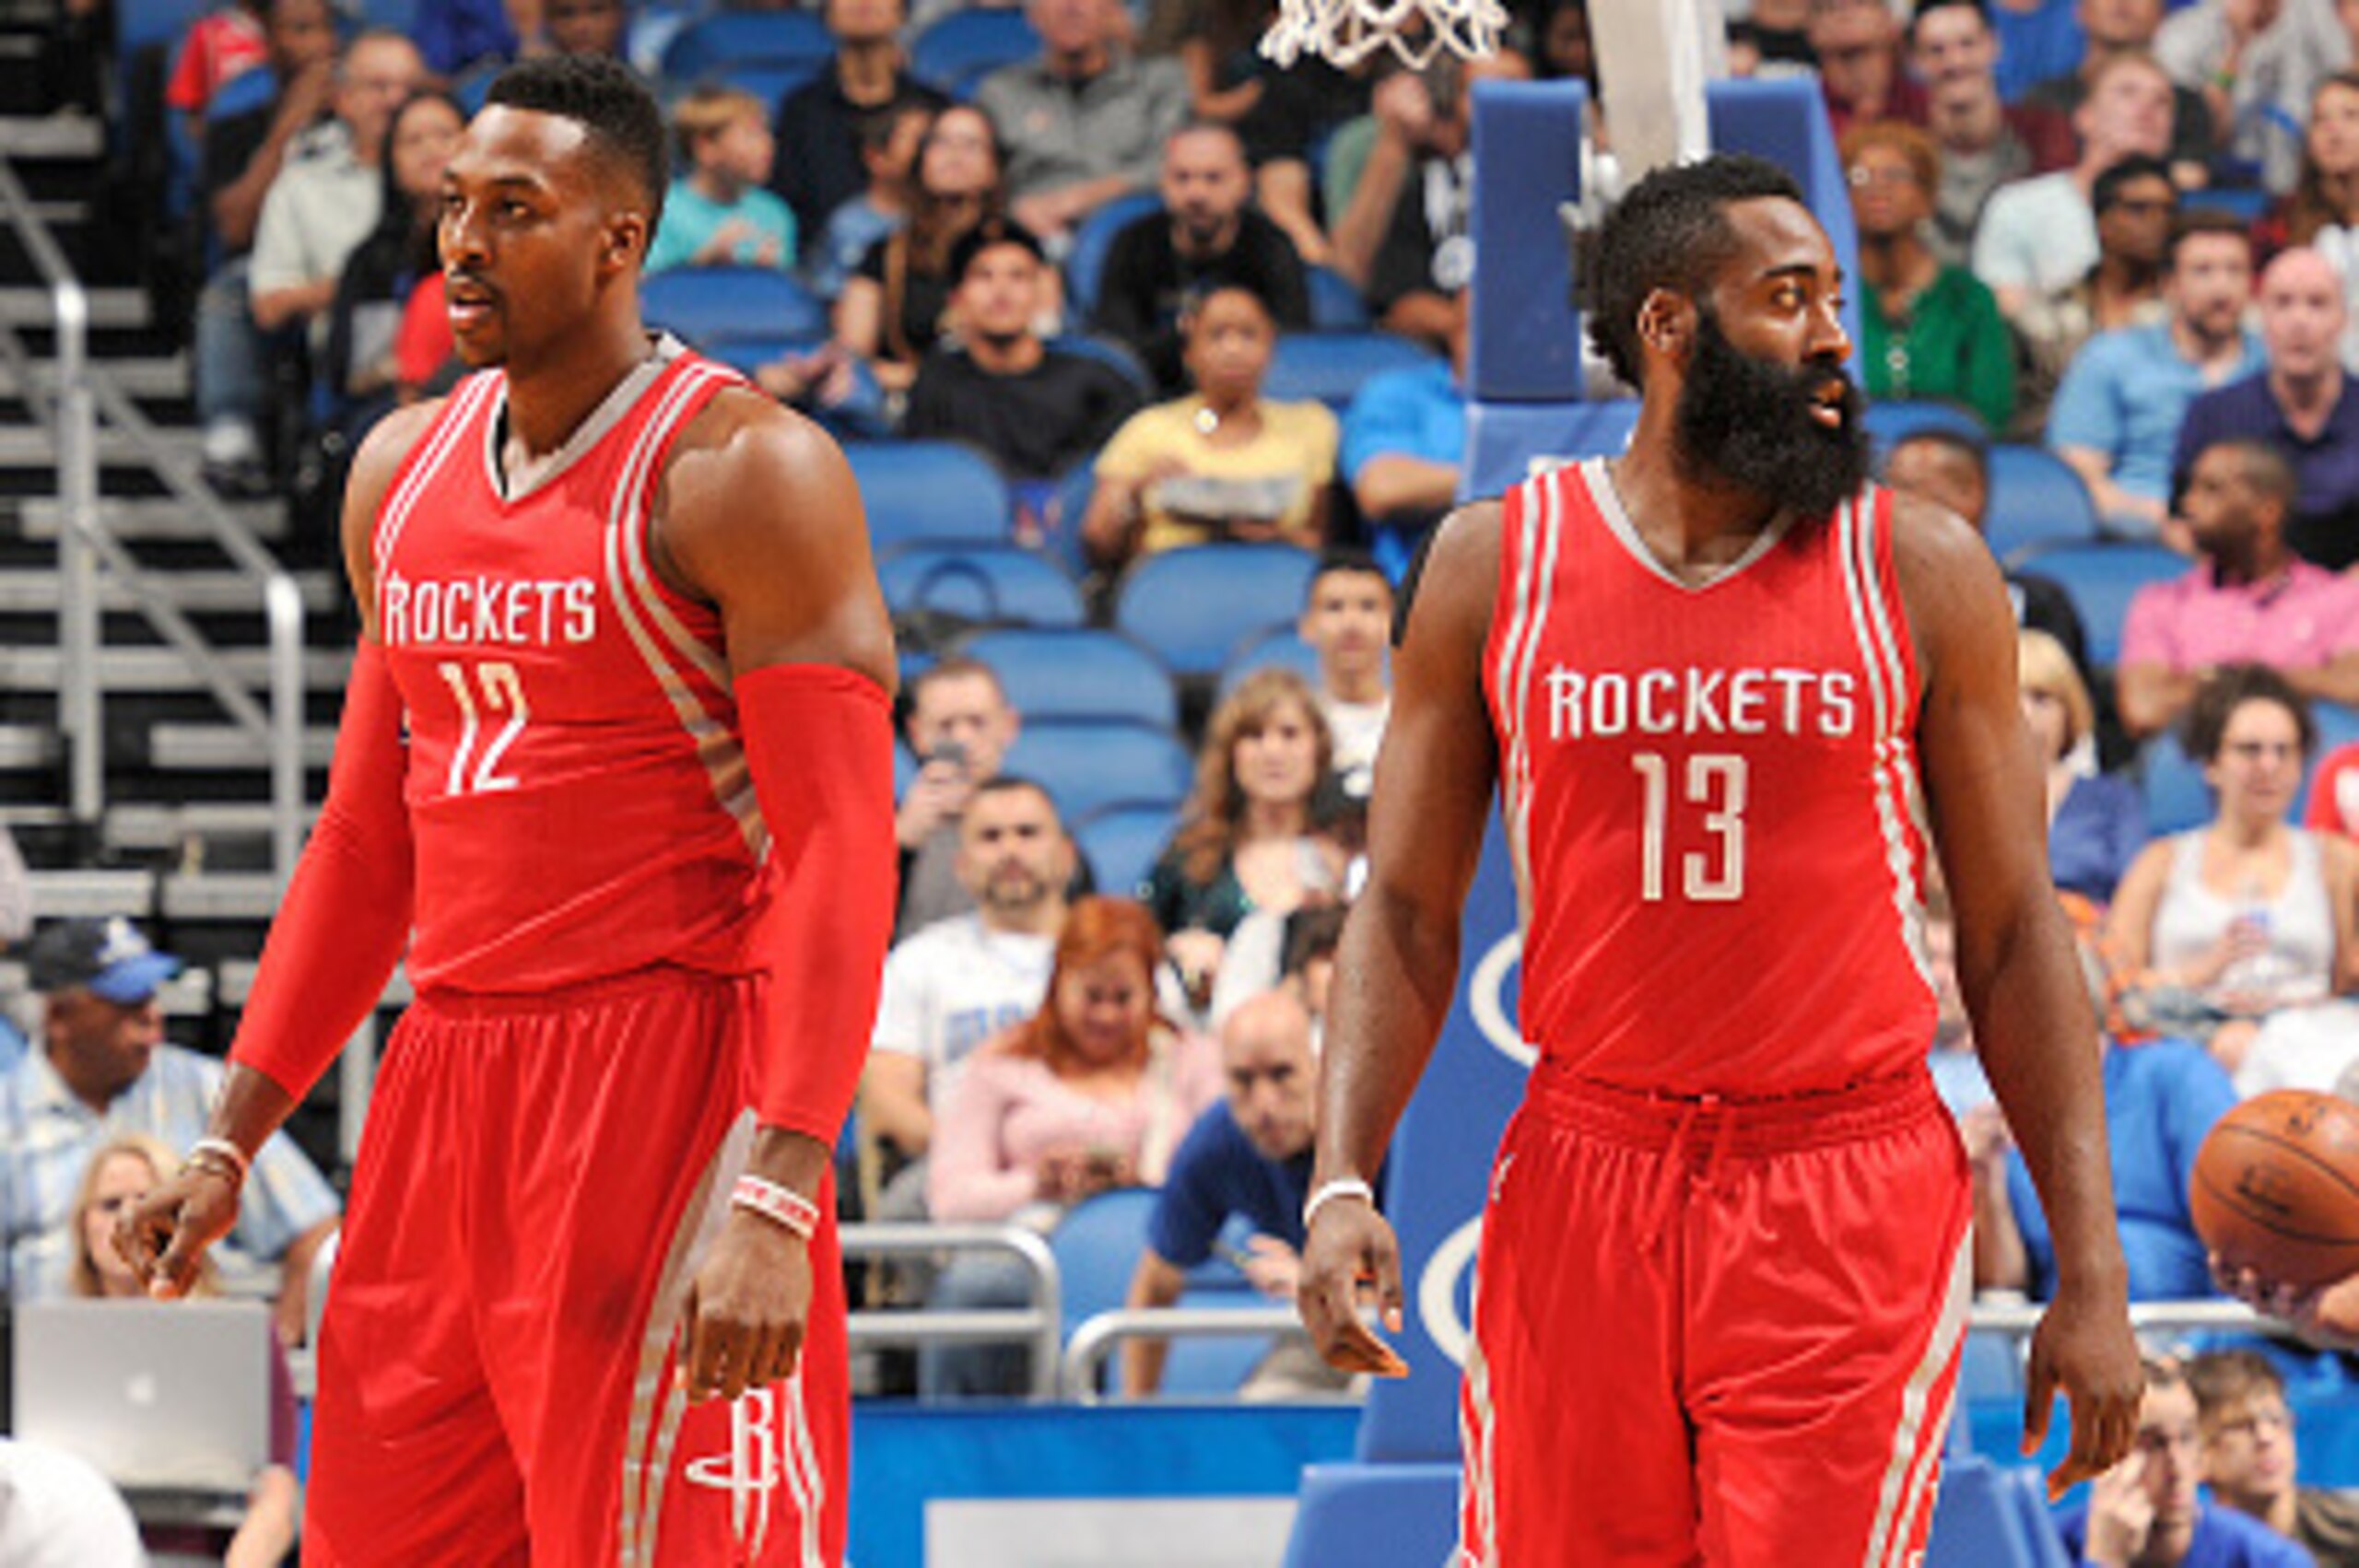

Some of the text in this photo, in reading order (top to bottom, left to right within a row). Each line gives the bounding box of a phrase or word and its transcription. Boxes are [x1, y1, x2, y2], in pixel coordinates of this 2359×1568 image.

[385, 569, 595, 647] ROCKETS
[438, 661, 530, 796] 12
[1545, 663, 1854, 740] ROCKETS
[1631, 752, 1747, 901] 13
